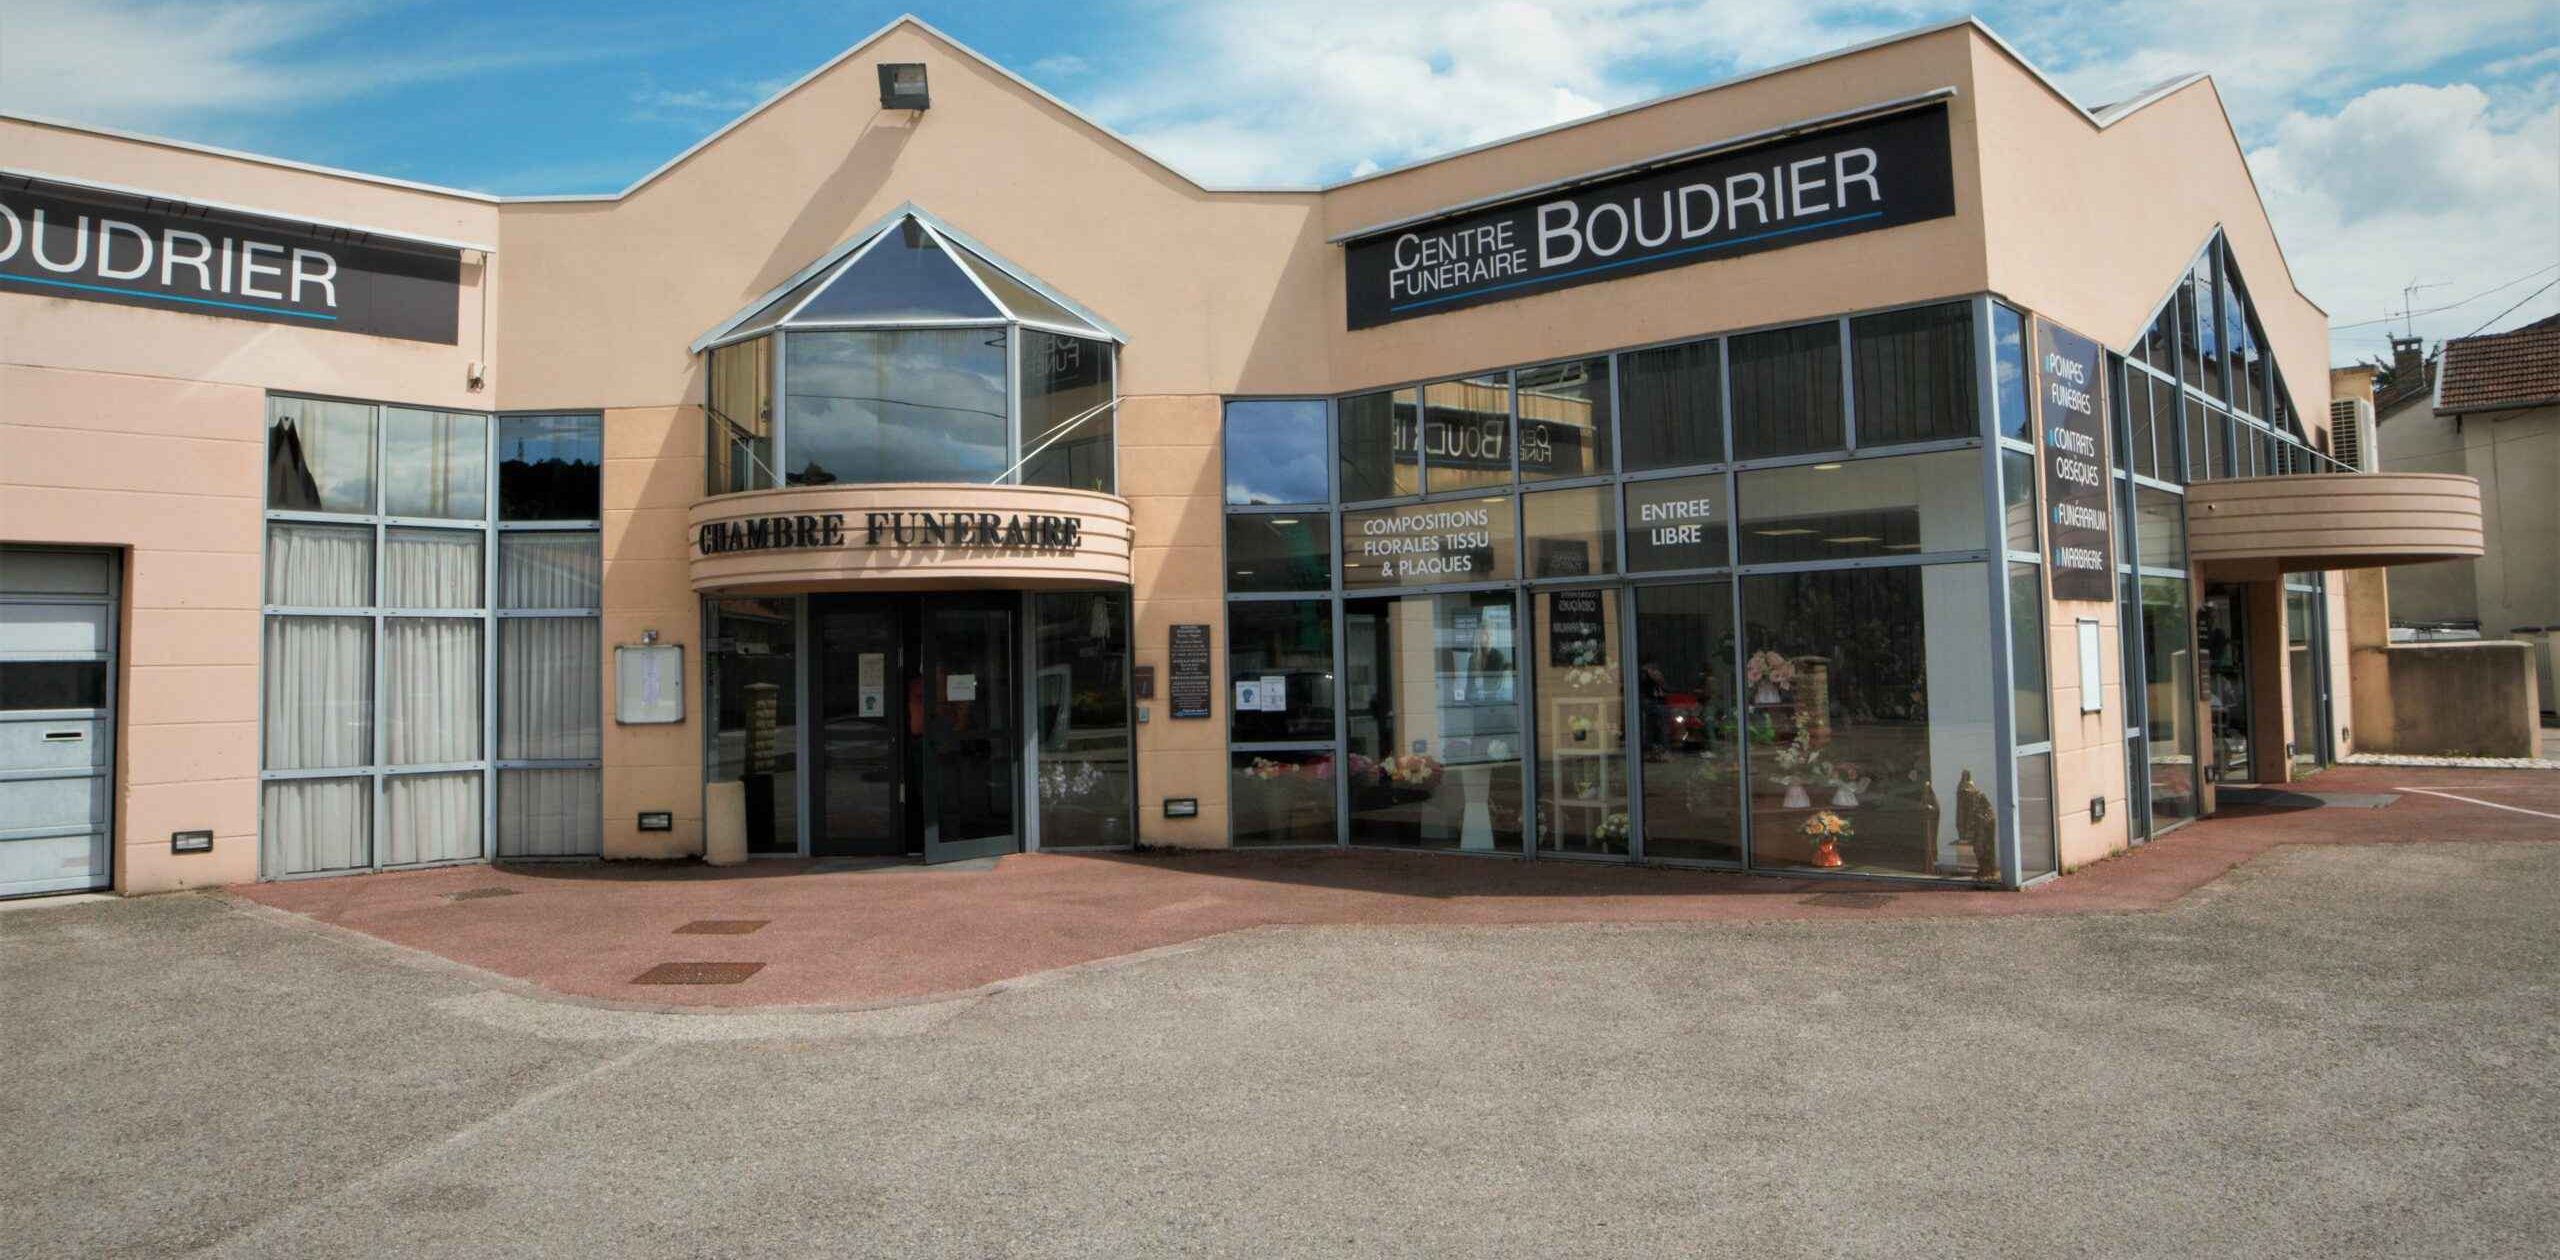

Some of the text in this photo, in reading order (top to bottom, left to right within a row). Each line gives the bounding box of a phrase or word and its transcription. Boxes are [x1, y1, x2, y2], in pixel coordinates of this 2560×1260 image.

[1538, 148, 1881, 268] BOUDRIER
[1395, 221, 1515, 271] CENTRE
[1390, 249, 1528, 299] FUNÉRAIRE
[2049, 353, 2084, 385] POMPES
[2051, 381, 2091, 415] FUNÈBRES
[2054, 427, 2095, 457] CONTRATS
[2056, 454, 2099, 487] OBSÈQUES
[1363, 509, 1489, 535] COMPOSITIONS
[1641, 499, 1710, 521] ENTREE
[2058, 500, 2107, 532] FUNÉRARIUM
[700, 512, 1083, 555] CHAMBRE FUNERAIRE
[1364, 531, 1489, 556] FLORALES TISSU
[1651, 525, 1702, 546] LIBRE
[1381, 555, 1472, 577] & PLAQUES
[2061, 546, 2103, 571] MARBRERIE
